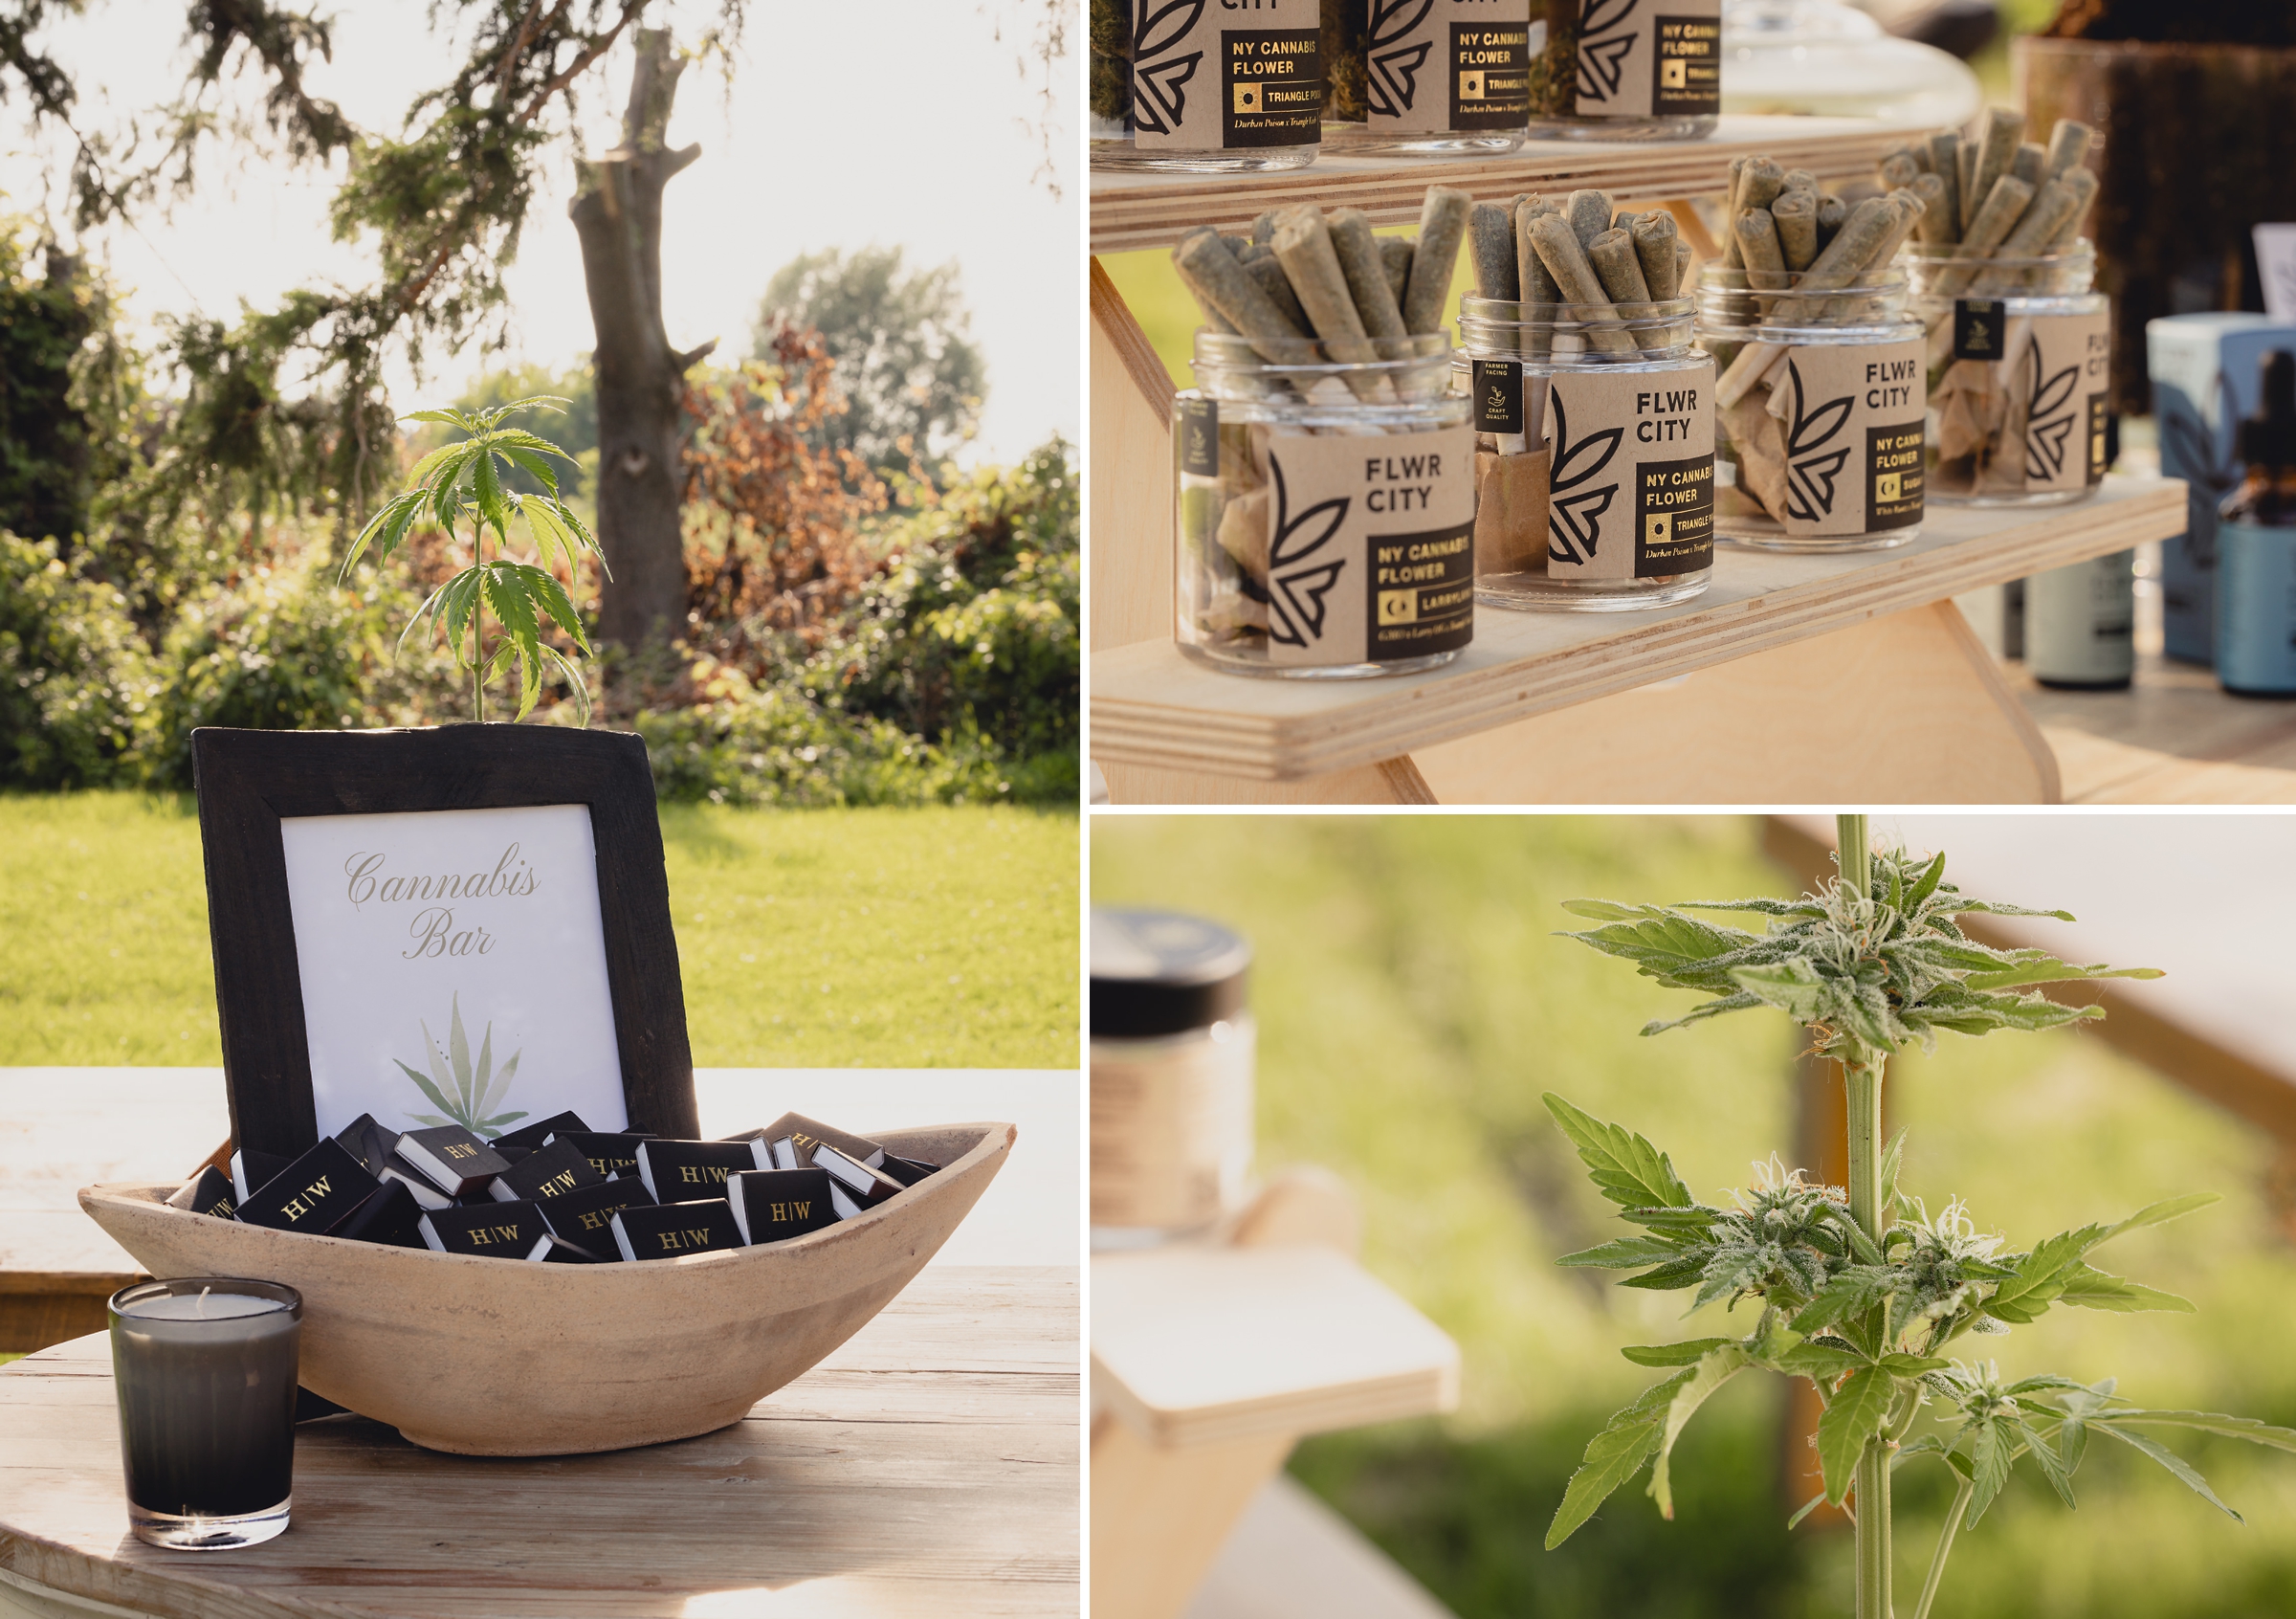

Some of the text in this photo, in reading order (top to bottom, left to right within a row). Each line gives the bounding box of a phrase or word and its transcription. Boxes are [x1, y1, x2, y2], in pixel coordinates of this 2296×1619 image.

[1233, 40, 1316, 55] NY CANNABIS
[1460, 33, 1480, 46] NY
[1460, 51, 1512, 64] FLOWER
[1233, 61, 1293, 75] FLOWER
[1268, 90, 1310, 102] TRIANGLE
[1234, 119, 1264, 129] Durban
[1264, 118, 1285, 128] Poison
[1866, 360, 1915, 383] FLWR
[1637, 389, 1697, 414] FLWR
[1866, 386, 1910, 410] CITY
[1637, 418, 1690, 443] CITY
[1876, 437, 1893, 452] NY
[1367, 455, 1440, 480] FLWR
[1876, 450, 1918, 469] FLOWER
[1646, 473, 1667, 487] NY
[1367, 485, 1433, 513] CITY
[1646, 488, 1697, 507] FLOWER
[1677, 515, 1709, 532] TRIANGLE
[1378, 545, 1404, 564] NY
[1378, 561, 1446, 585] FLOWER
[344, 841, 541, 912] Cannabis
[402, 907, 497, 960] Bar
